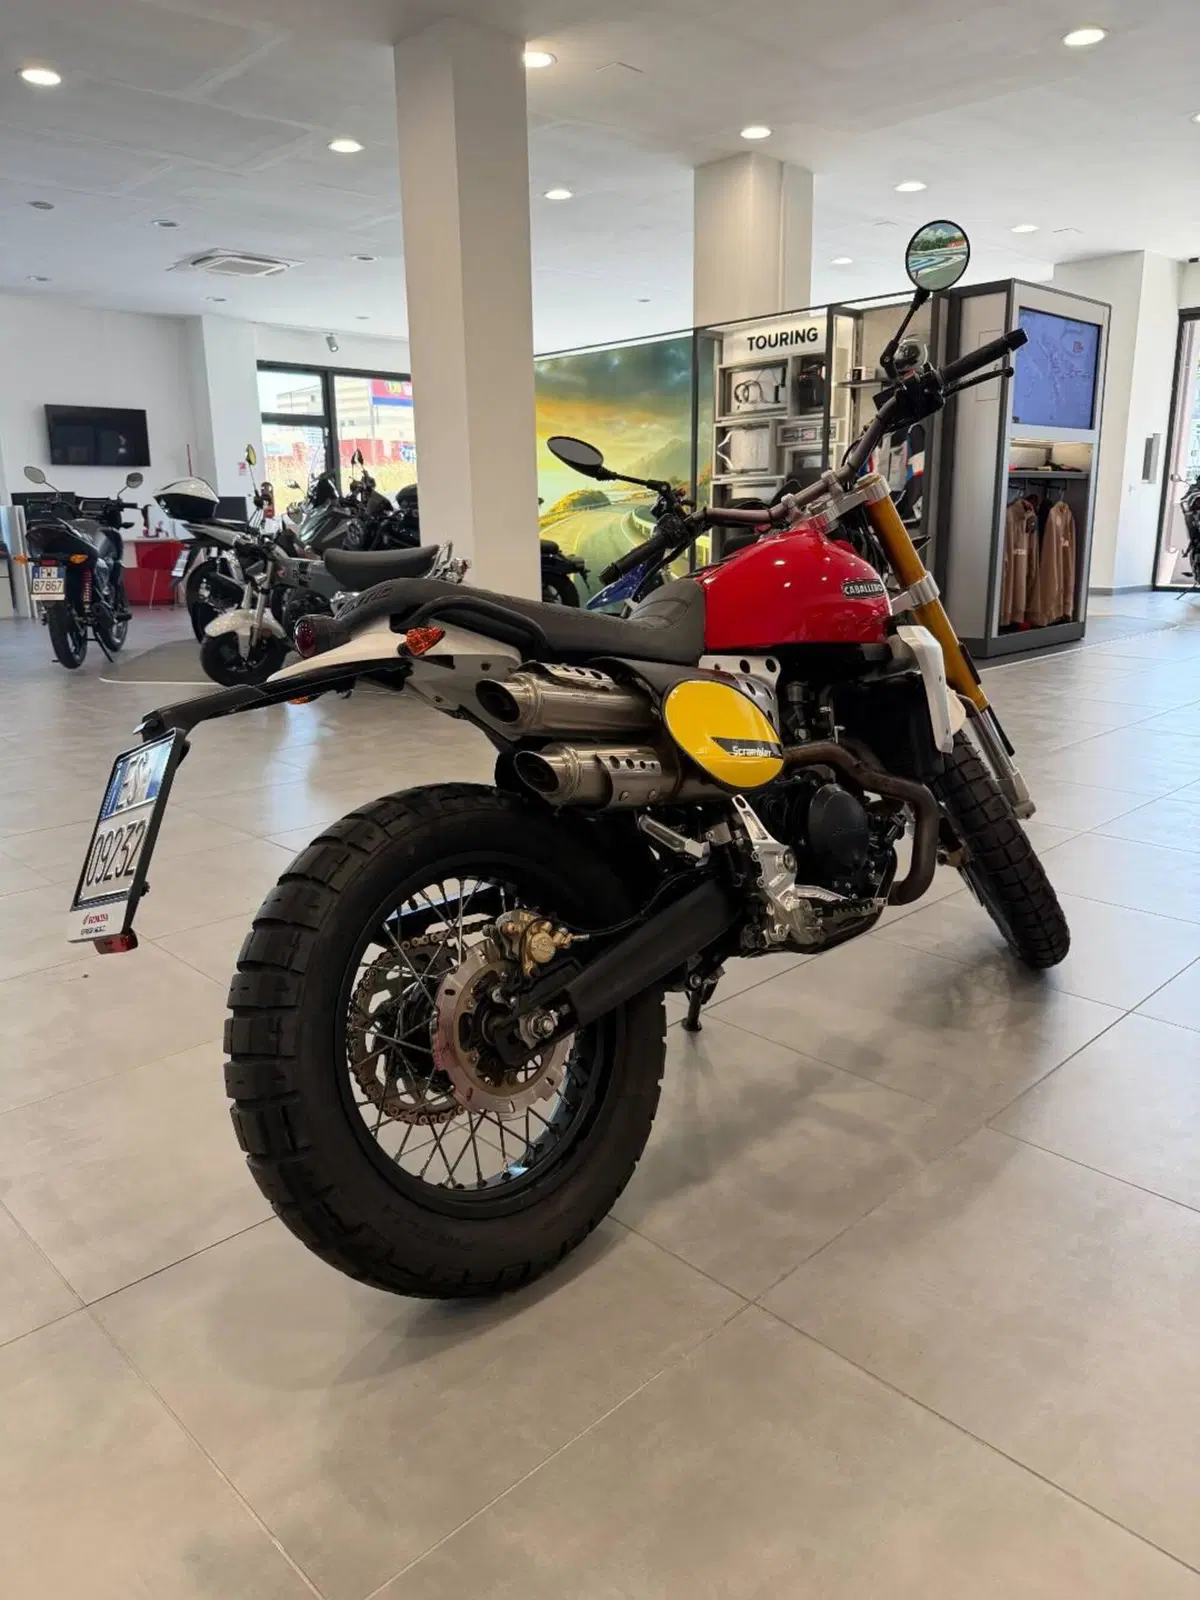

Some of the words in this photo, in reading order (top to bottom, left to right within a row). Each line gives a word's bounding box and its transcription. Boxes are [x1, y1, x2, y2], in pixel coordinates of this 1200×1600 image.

[747, 327, 818, 351] TOURING
[844, 583, 883, 595] CABALLERO
[731, 745, 772, 757] Scrambler
[86, 819, 147, 886] 09232
